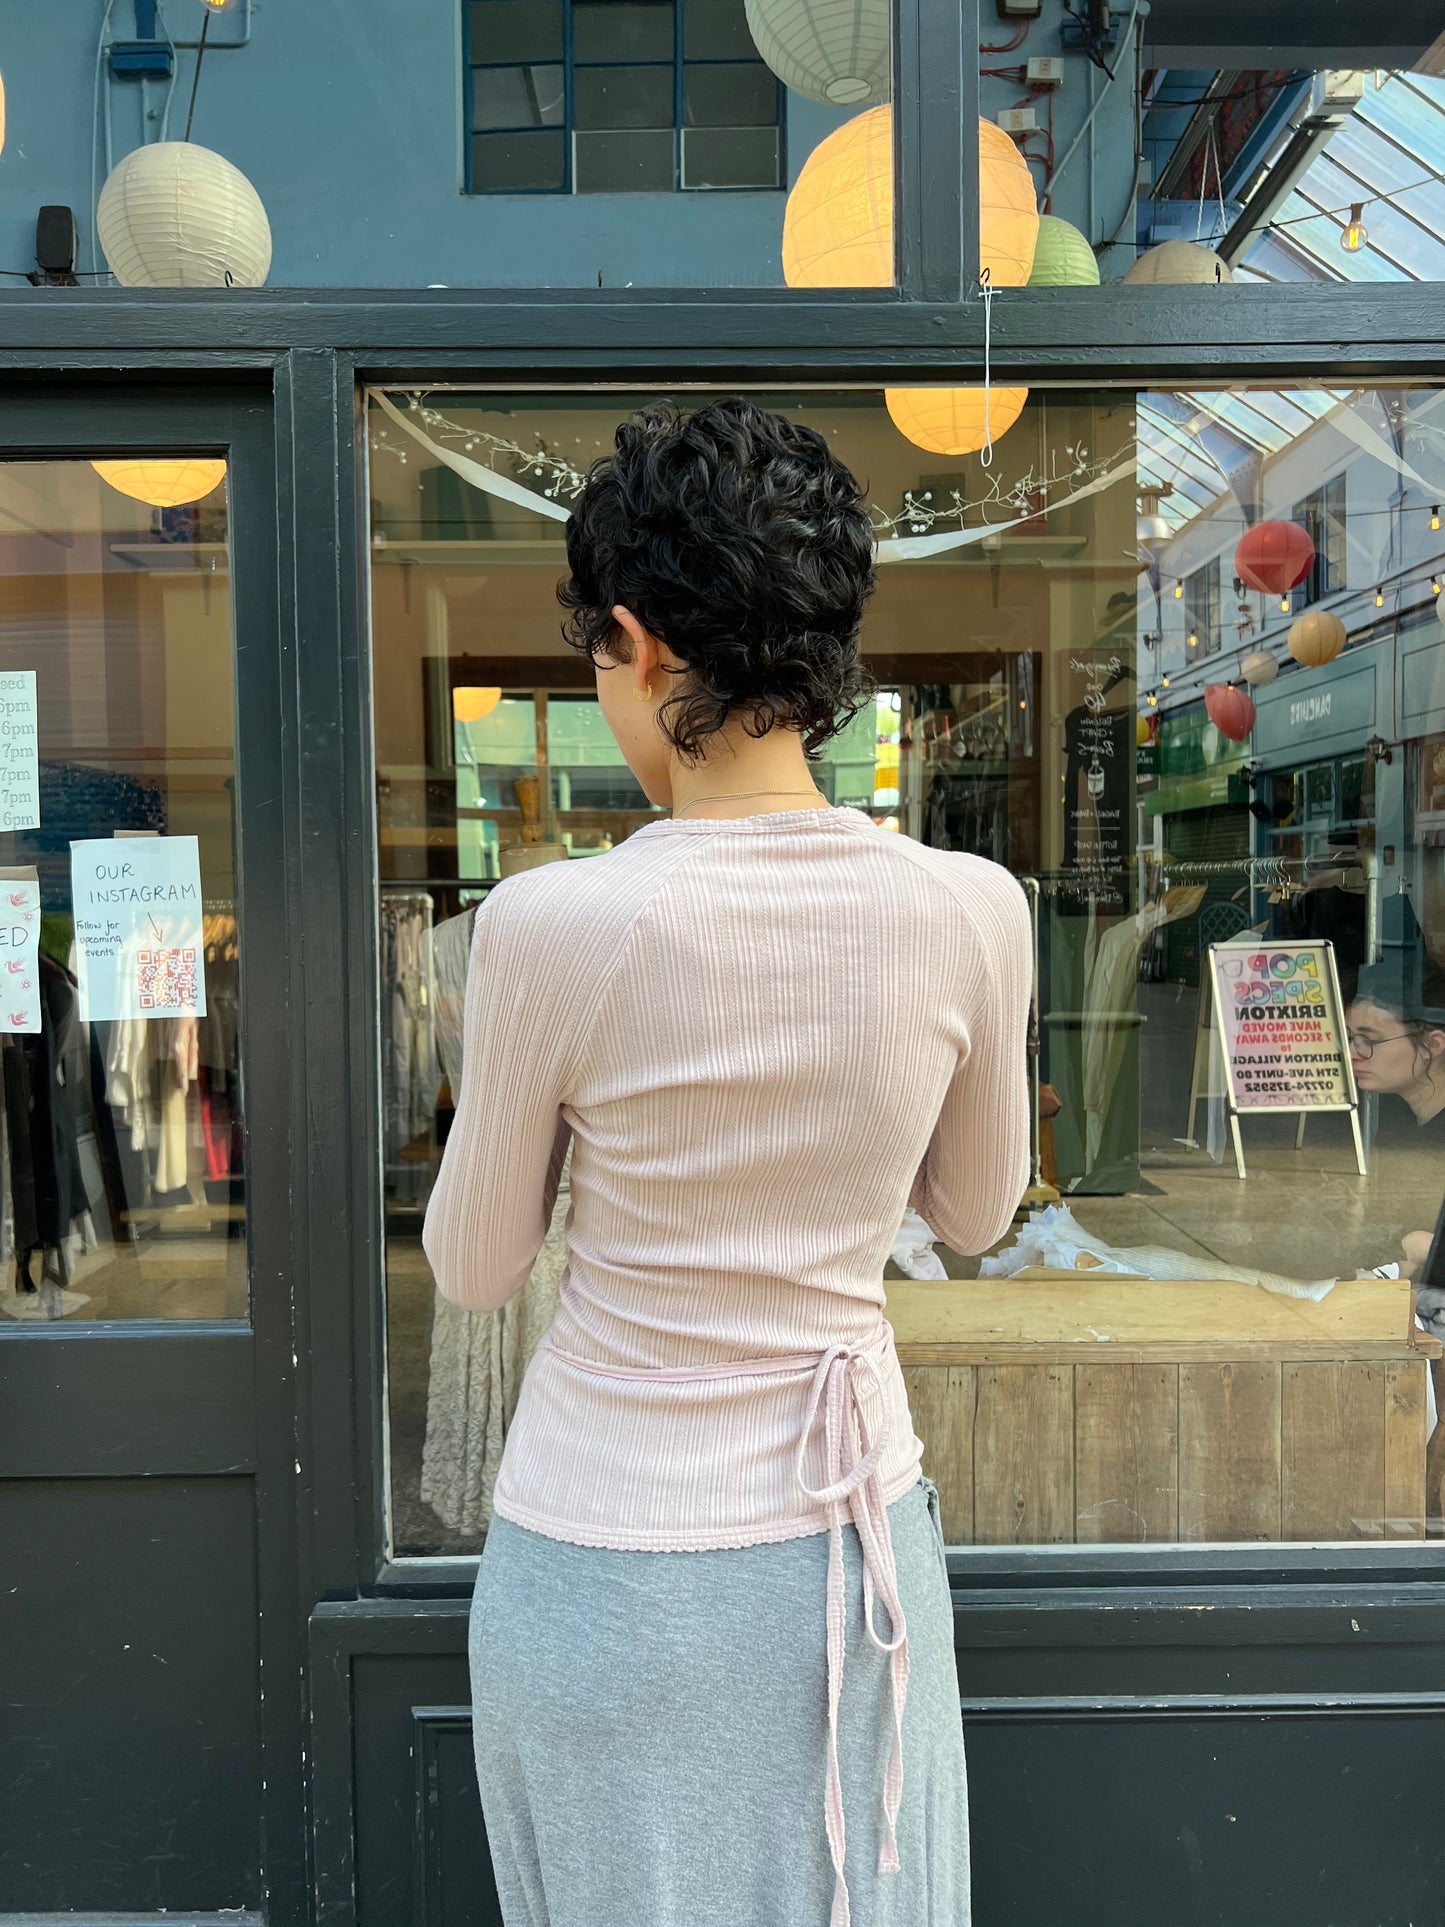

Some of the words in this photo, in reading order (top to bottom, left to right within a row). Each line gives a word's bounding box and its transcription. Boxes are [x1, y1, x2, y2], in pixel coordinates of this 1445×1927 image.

[0, 674, 26, 690] sed
[2, 720, 35, 739] 6pm
[2, 743, 34, 762] 7pm
[0, 767, 31, 785] 7pm
[1, 790, 32, 807] 7pm
[2, 811, 35, 829] 6pm
[95, 863, 135, 880] OUR
[89, 883, 197, 904] INSTAGRAM
[0, 926, 29, 947] ED
[76, 920, 101, 930] Follow
[105, 919, 120, 936] for
[80, 935, 124, 949] upcoming
